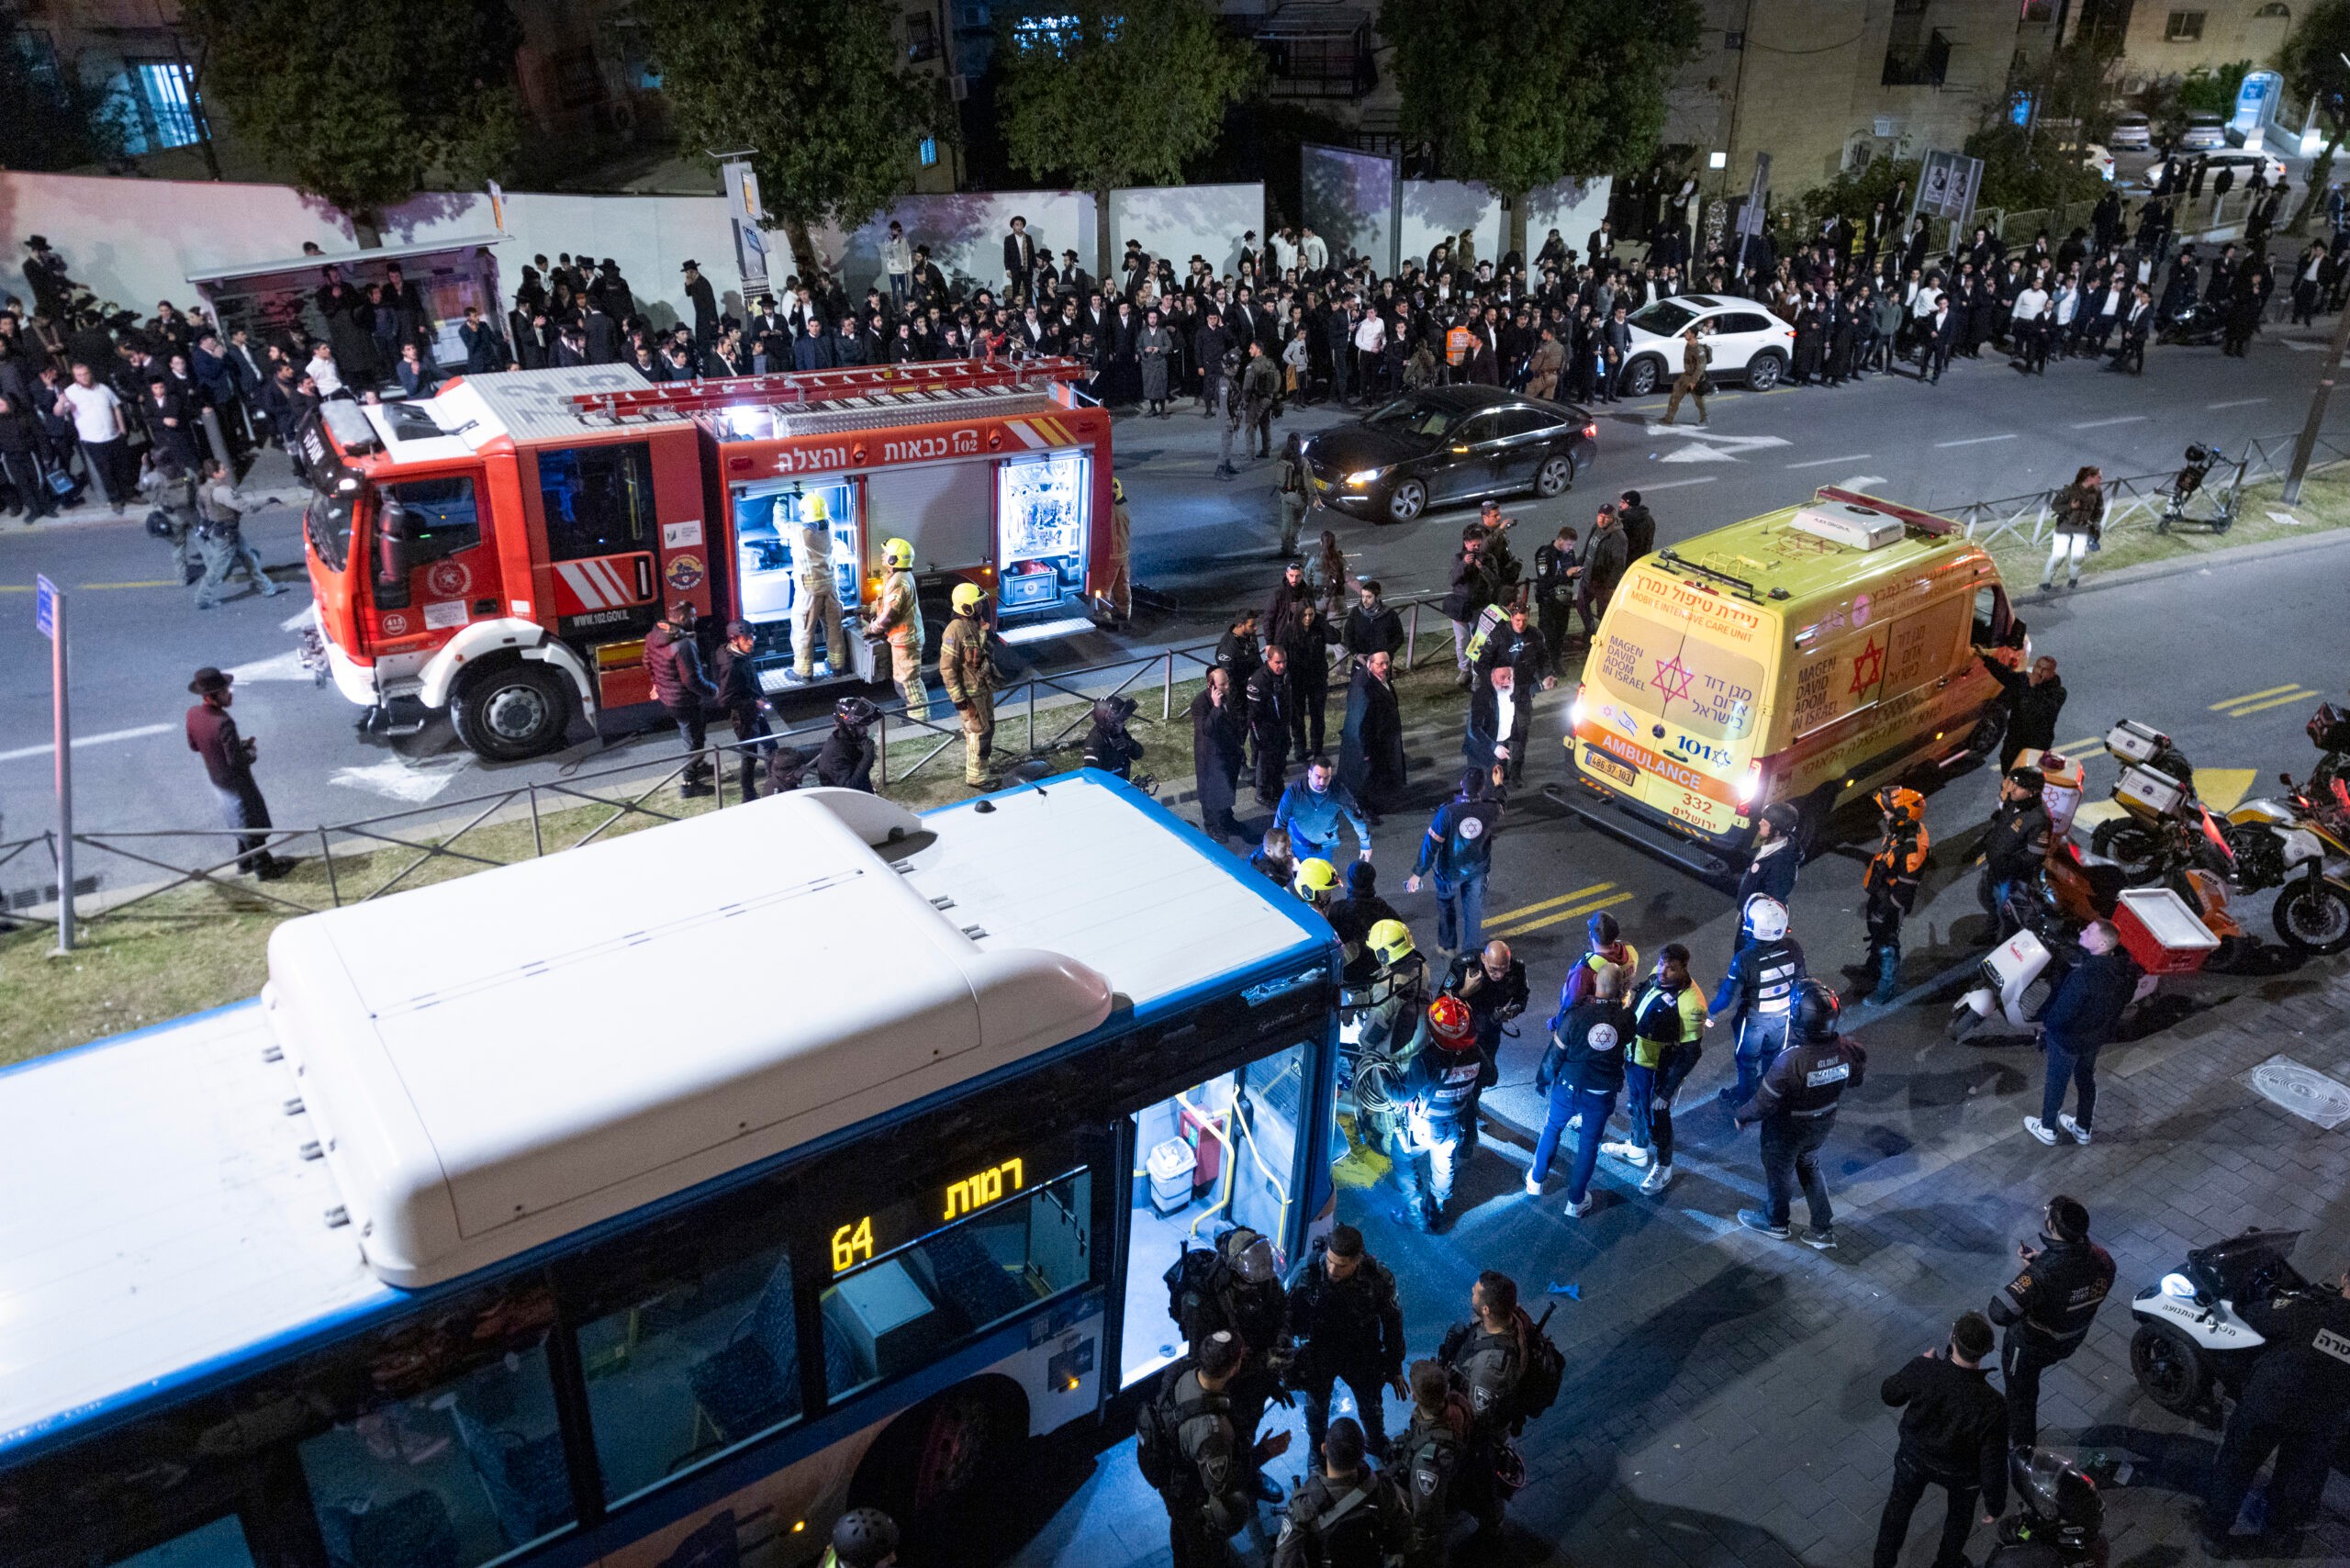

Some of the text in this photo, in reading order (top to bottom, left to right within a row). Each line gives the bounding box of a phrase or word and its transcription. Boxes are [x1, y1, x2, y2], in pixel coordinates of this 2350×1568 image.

[1300, 346, 1304, 355] 8
[778, 437, 947, 473] כבאות והצלה
[954, 439, 978, 454] 102
[1637, 575, 1759, 629] ניידת טיפול נמרץ
[386, 618, 403, 626] 415
[573, 610, 630, 628] WWW.102.GOV.IL
[1630, 590, 1754, 643] MOBILE INTENSIVE CARE UNIT
[1606, 645, 1636, 665] DAVID
[1609, 635, 1644, 657] MAGEN
[1602, 664, 1646, 691] IN ISRAEL
[1605, 655, 1634, 675] ADOM
[1798, 656, 1836, 685] MAGEN
[1705, 675, 1752, 701] מגן דוד
[1796, 675, 1830, 700] DAVID
[1692, 699, 1743, 730] בישראל
[1713, 694, 1746, 716] אדום
[1793, 691, 1827, 716] ADOM
[1791, 700, 1837, 733] IN ISRAEL
[1677, 735, 1711, 760] 101
[1602, 734, 1702, 790] AMBULANCE
[1682, 792, 1713, 815] 332
[1672, 806, 1718, 830] ירושלים
[944, 1157, 1023, 1221] רמות
[832, 1216, 873, 1271] 64
[2162, 1304, 2195, 1319] התנועה
